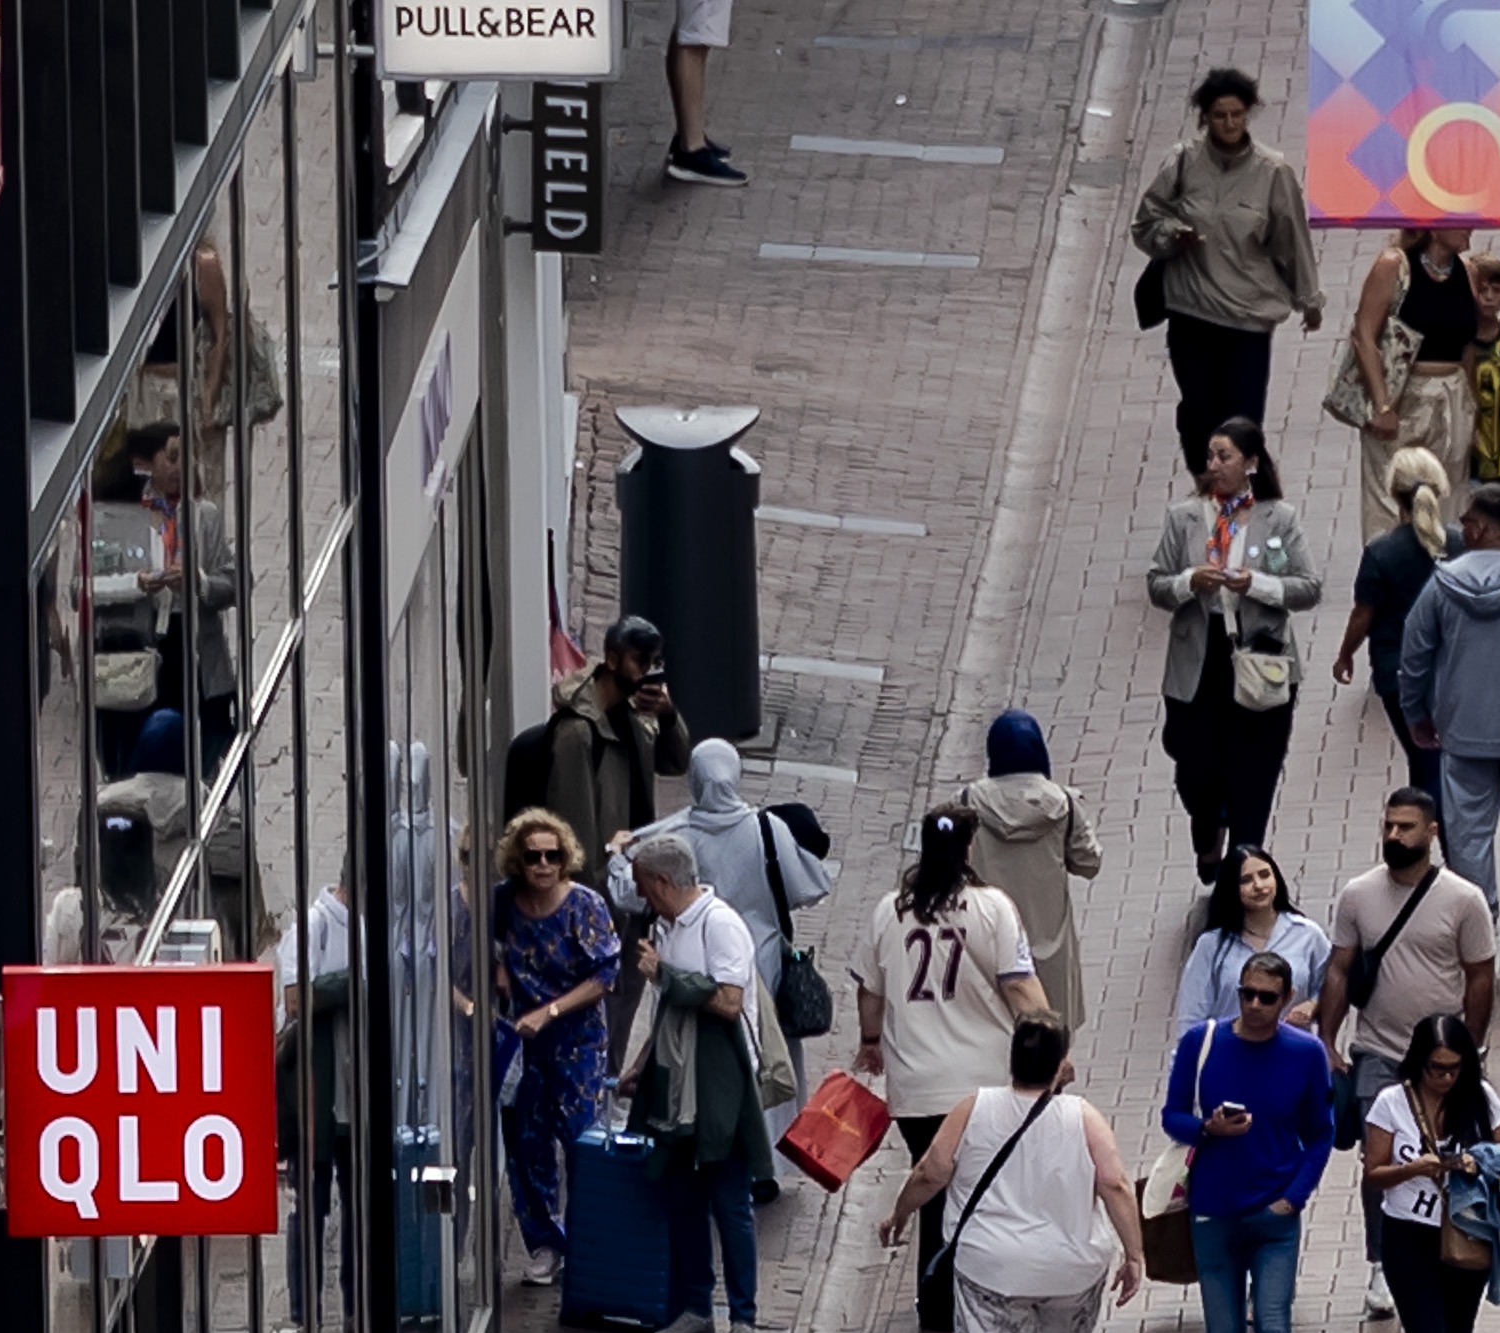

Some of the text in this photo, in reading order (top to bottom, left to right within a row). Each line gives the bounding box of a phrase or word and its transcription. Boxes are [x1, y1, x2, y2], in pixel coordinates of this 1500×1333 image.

[395, 6, 597, 38] PULL&BEAR
[545, 82, 589, 240] FIELD
[905, 927, 967, 1002] 27
[37, 1006, 222, 1095] UNI
[39, 1114, 244, 1219] QLO
